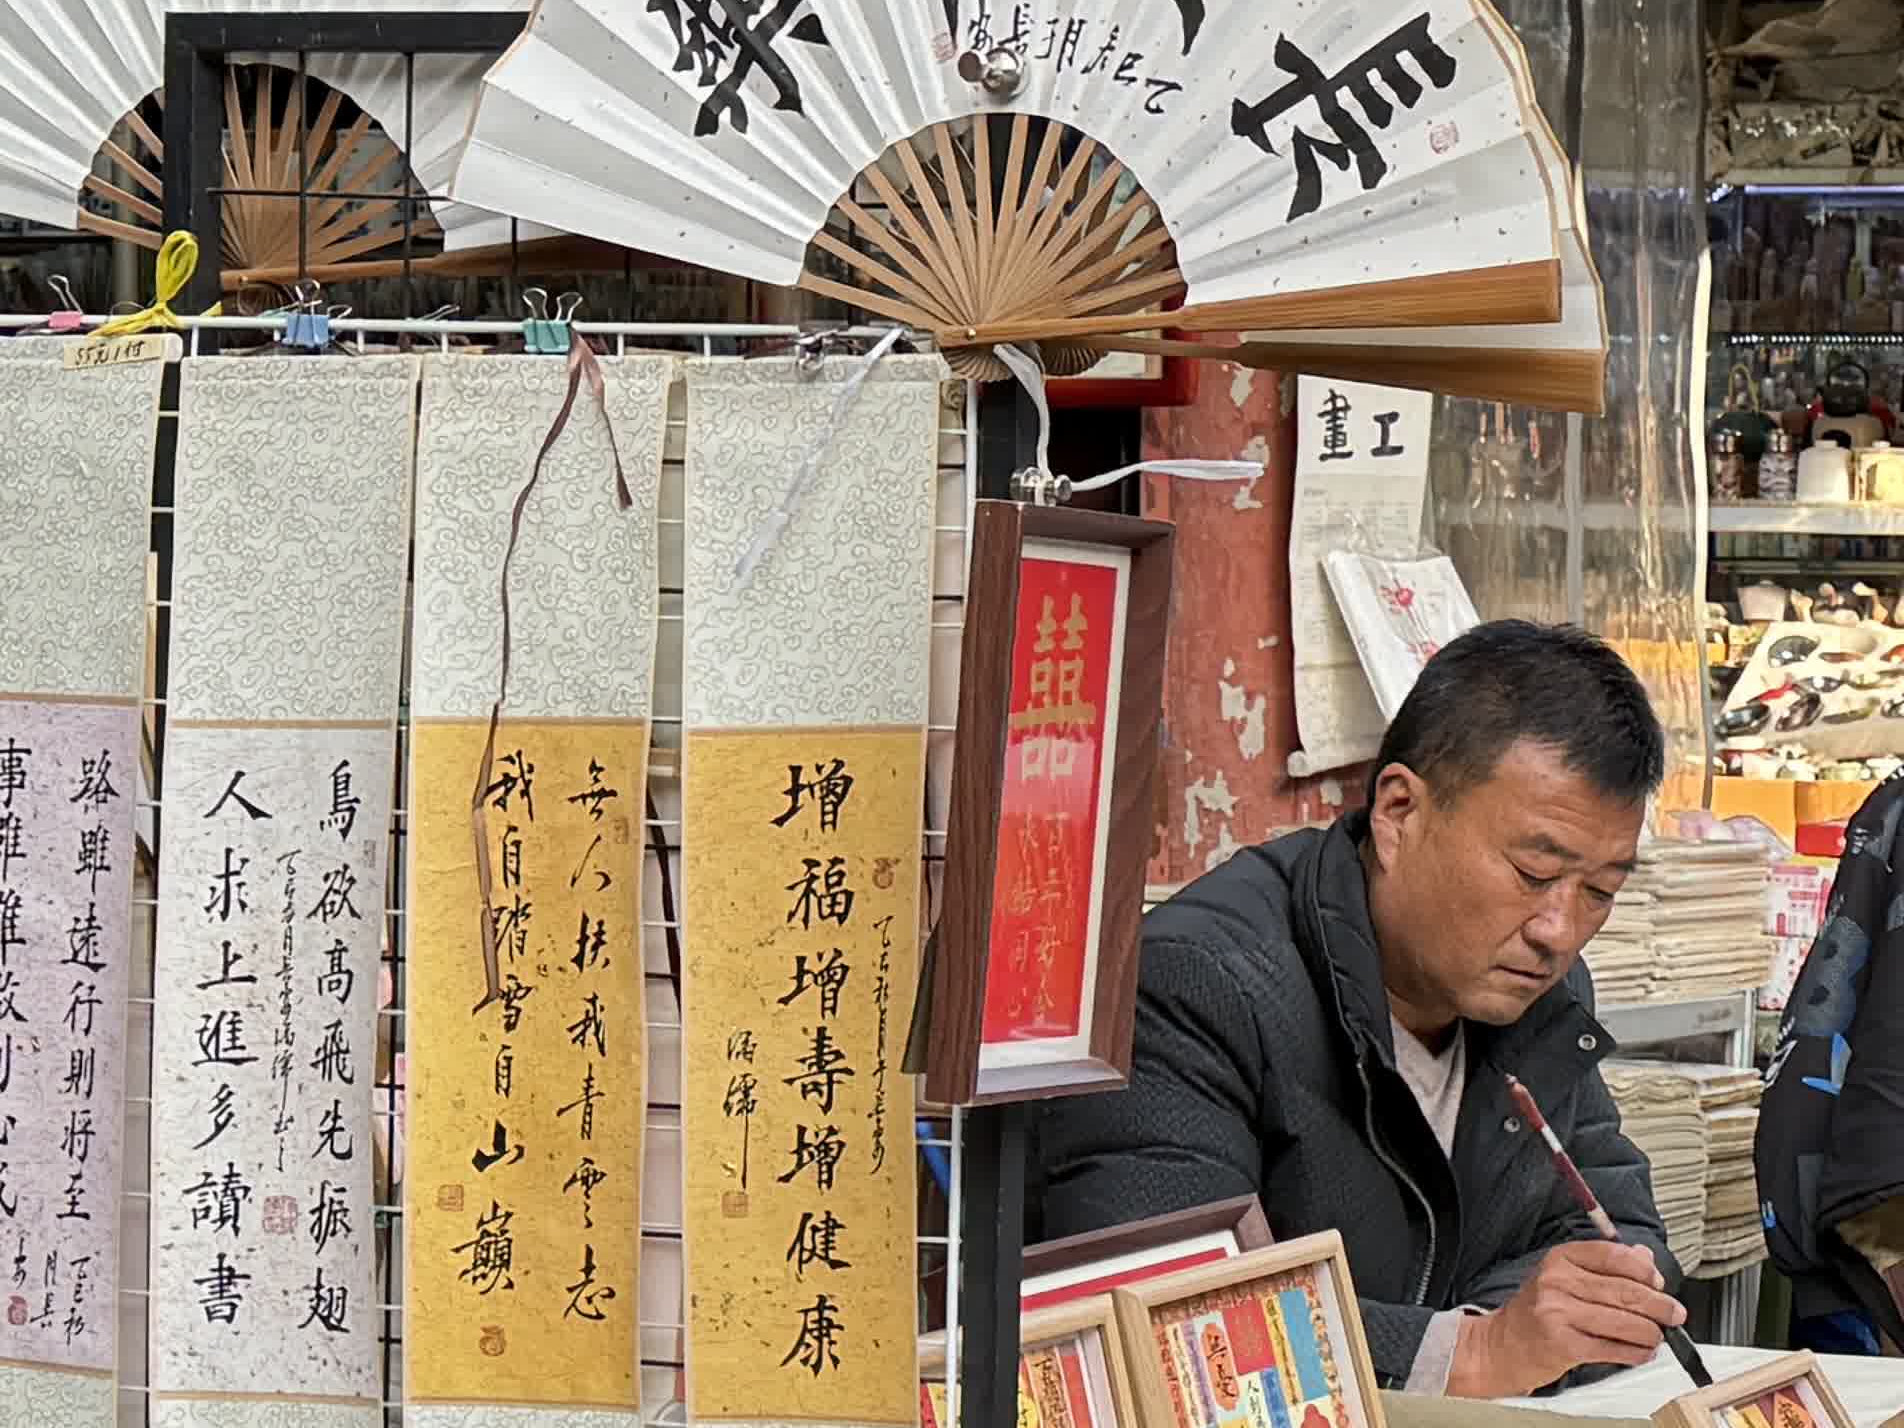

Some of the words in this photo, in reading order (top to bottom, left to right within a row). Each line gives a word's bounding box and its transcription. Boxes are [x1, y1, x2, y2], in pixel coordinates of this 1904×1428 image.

[182, 769, 273, 1326] 人求上進多讀書
[297, 759, 363, 1335] 鳥欲高飛先振翅
[769, 758, 856, 1376] 增福增壽增健康
